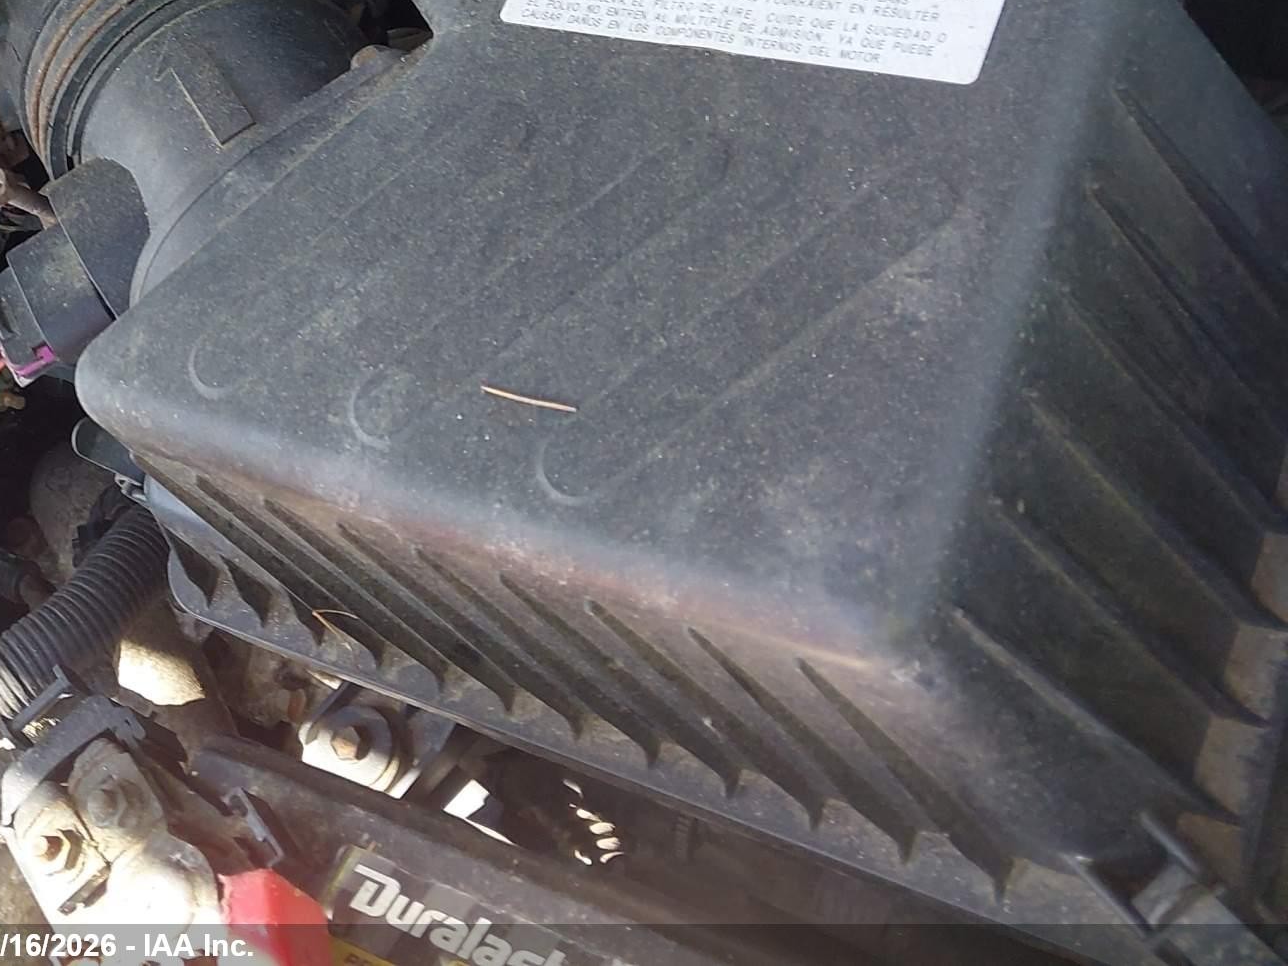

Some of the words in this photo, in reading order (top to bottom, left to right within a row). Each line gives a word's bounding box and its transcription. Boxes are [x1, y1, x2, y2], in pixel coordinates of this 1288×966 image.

[546, 0, 579, 11] POLVO
[586, 4, 601, 14] NO
[606, 6, 648, 20] ENTREN
[738, 22, 755, 32] DE
[838, 35, 854, 45] YA
[860, 38, 886, 49] QUE
[892, 42, 935, 56] PUEDE
[699, 3, 715, 13] DE
[766, 12, 805, 25] CUIDE
[810, 18, 836, 29] QUE
[842, 22, 858, 32] LA
[865, 24, 931, 41] SUCIEDAD
[936, 33, 948, 43] O
[849, 3, 866, 13] EN
[521, 8, 562, 21] CAUSAR
[608, 20, 621, 30] EN
[629, 22, 649, 32] LOS
[656, 24, 735, 44] COMPONENTES
[741, 36, 802, 52] INTERNOS
[808, 45, 833, 56] DEL
